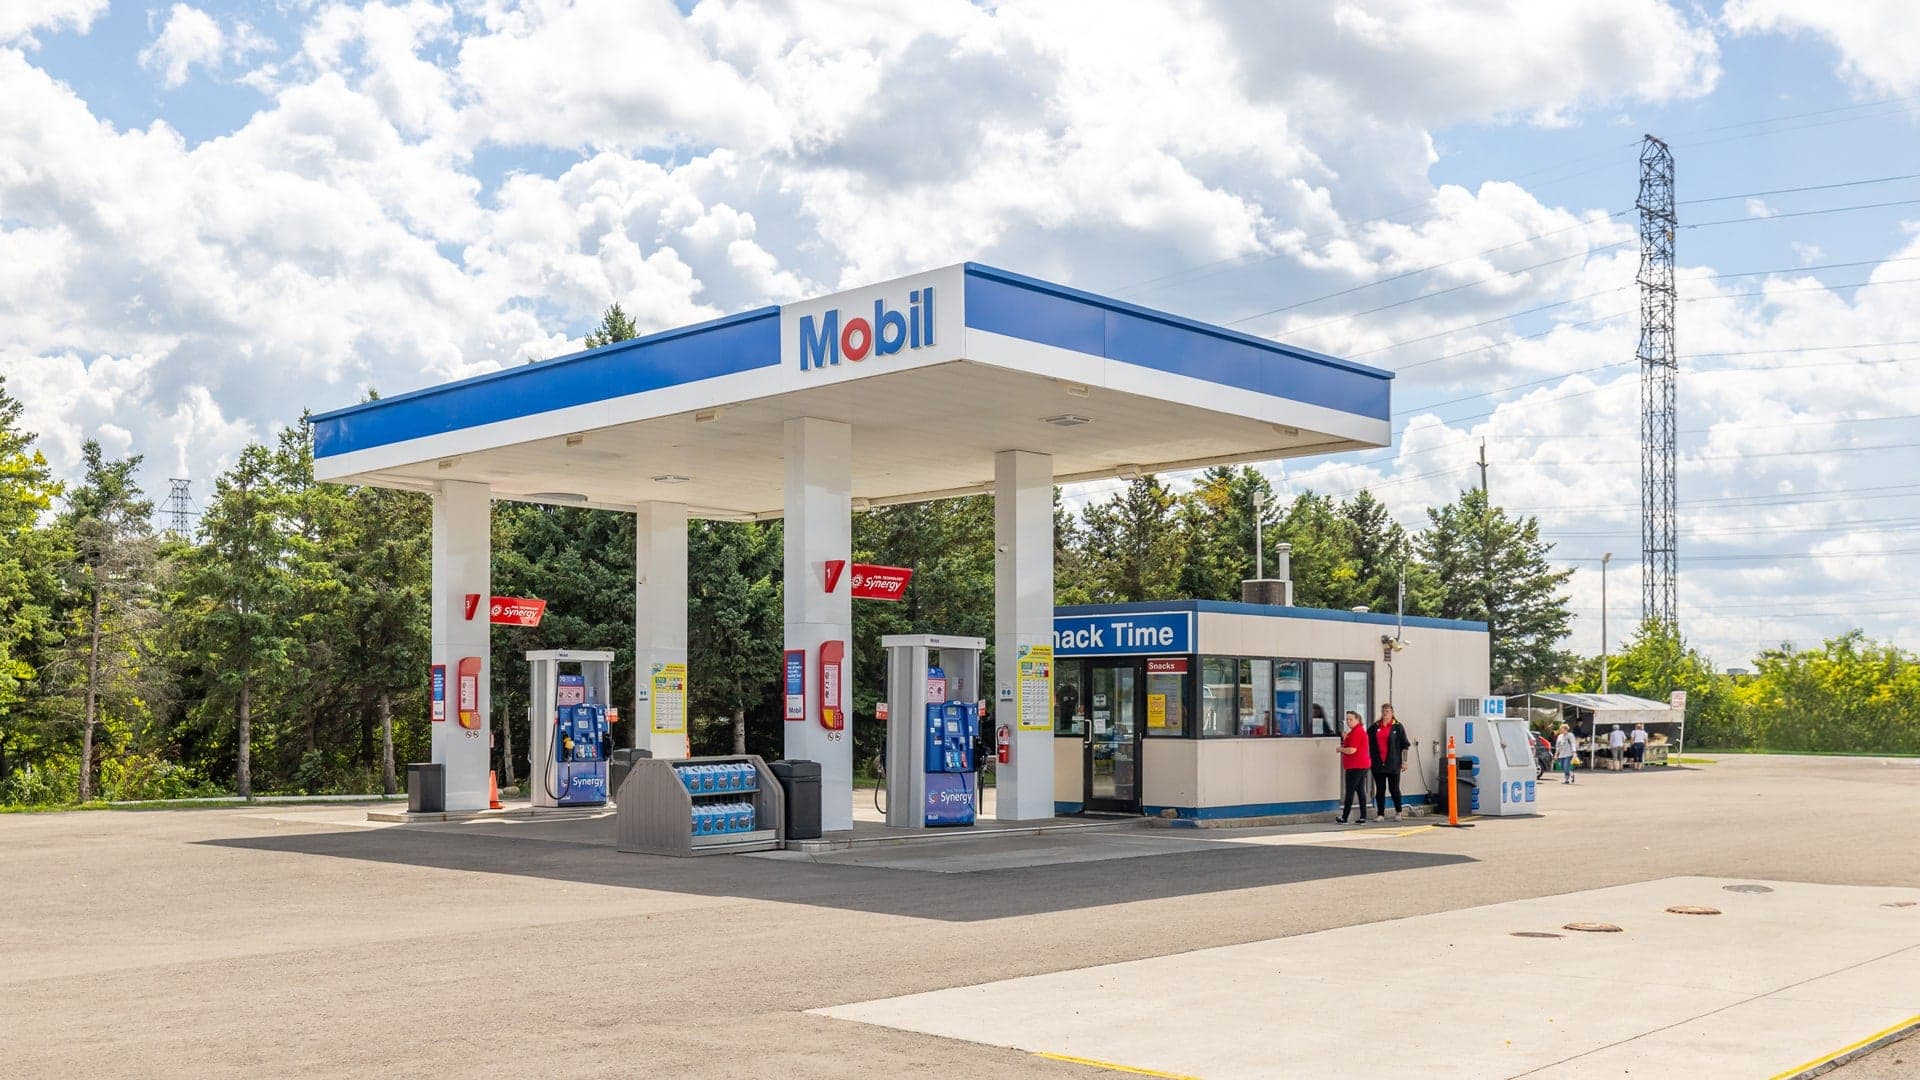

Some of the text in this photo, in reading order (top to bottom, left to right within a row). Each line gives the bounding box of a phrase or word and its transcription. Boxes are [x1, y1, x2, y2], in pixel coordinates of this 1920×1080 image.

[799, 286, 935, 371] Mobil
[827, 568, 831, 578] 1
[864, 577, 902, 592] Synergy
[503, 607, 537, 618] Synergy
[1053, 622, 1174, 648] nack Time
[1148, 662, 1175, 670] Snacks
[1484, 699, 1504, 714] ICE
[573, 776, 604, 788] Synergy
[940, 791, 972, 806] Synergy
[1502, 781, 1536, 803] ICE
